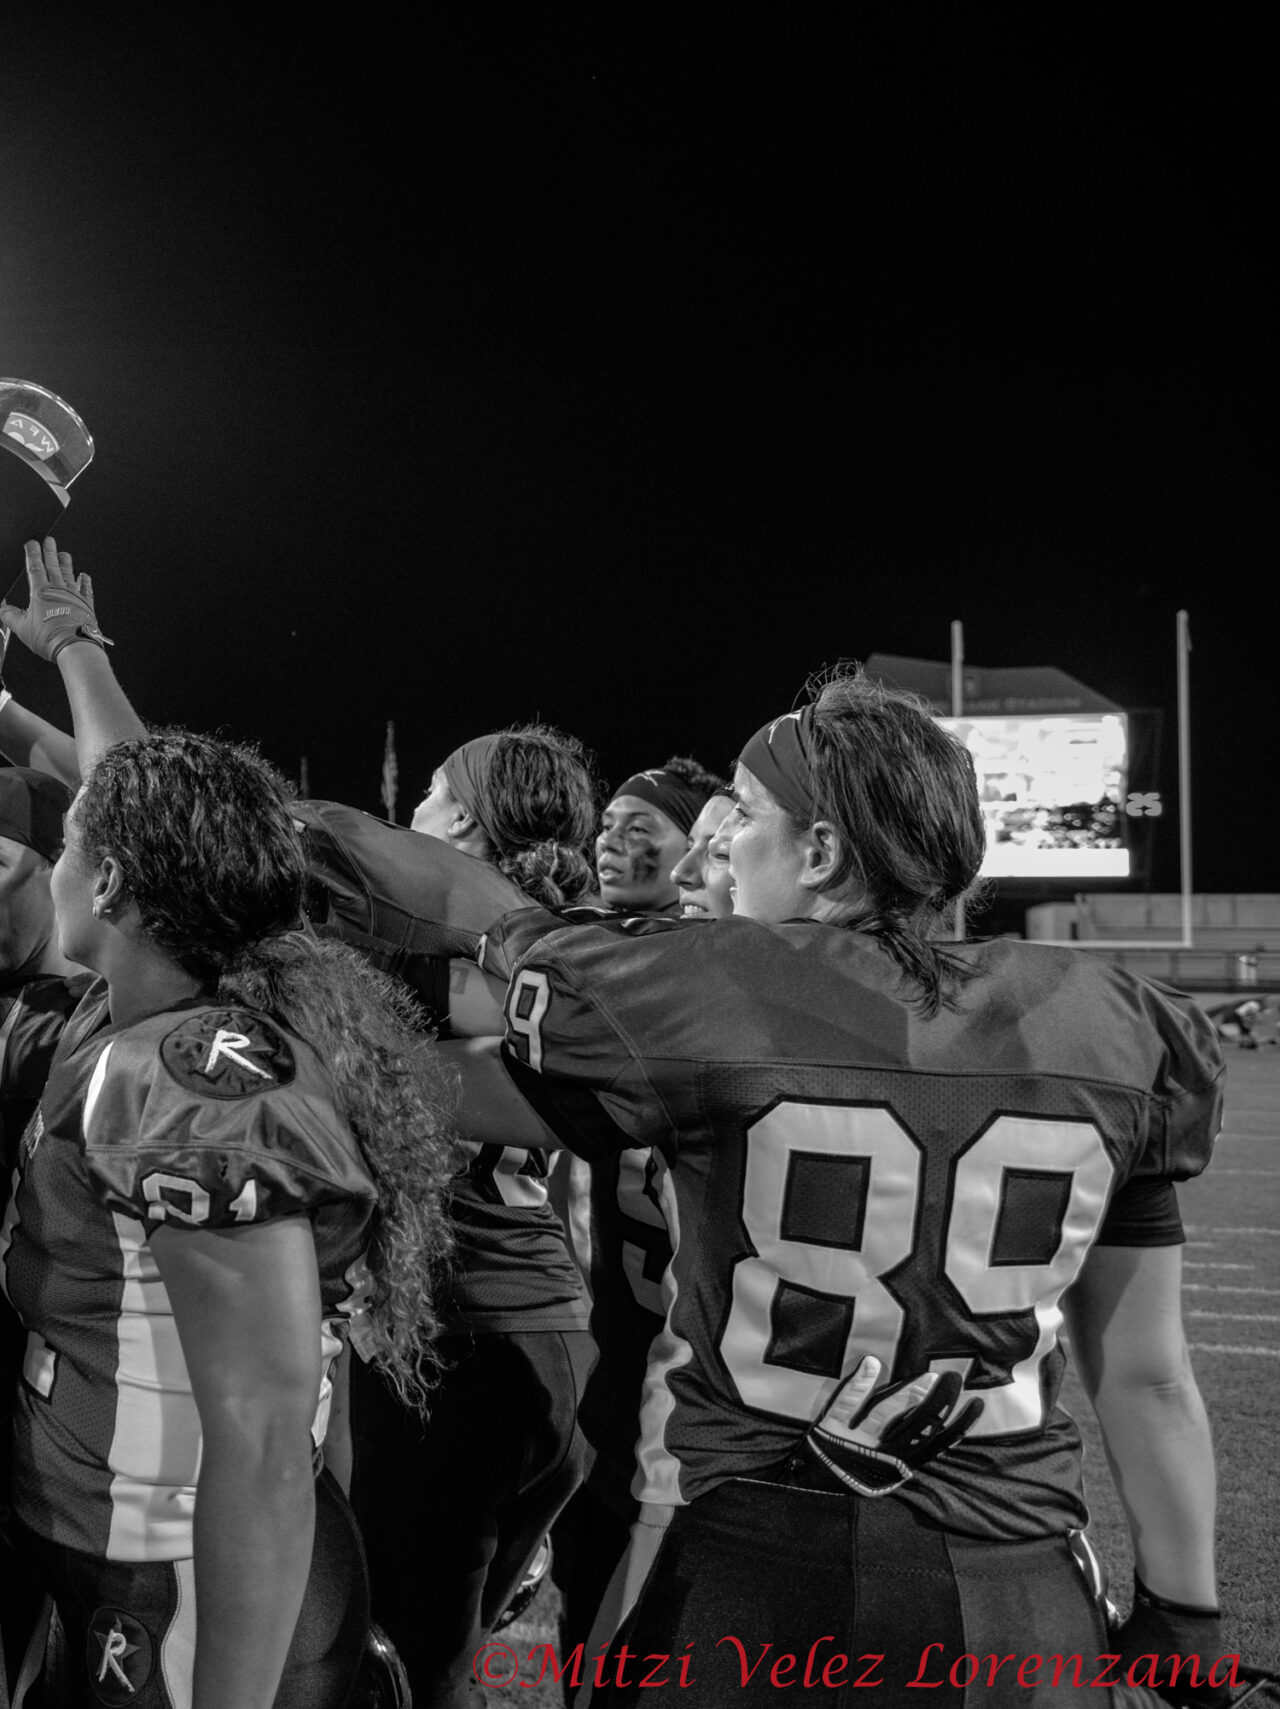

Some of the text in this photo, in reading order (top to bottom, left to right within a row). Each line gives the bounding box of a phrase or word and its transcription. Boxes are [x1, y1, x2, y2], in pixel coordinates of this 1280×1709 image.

[205, 1029, 274, 1079] R
[720, 1101, 1116, 1438] 89
[98, 1627, 135, 1693] R
